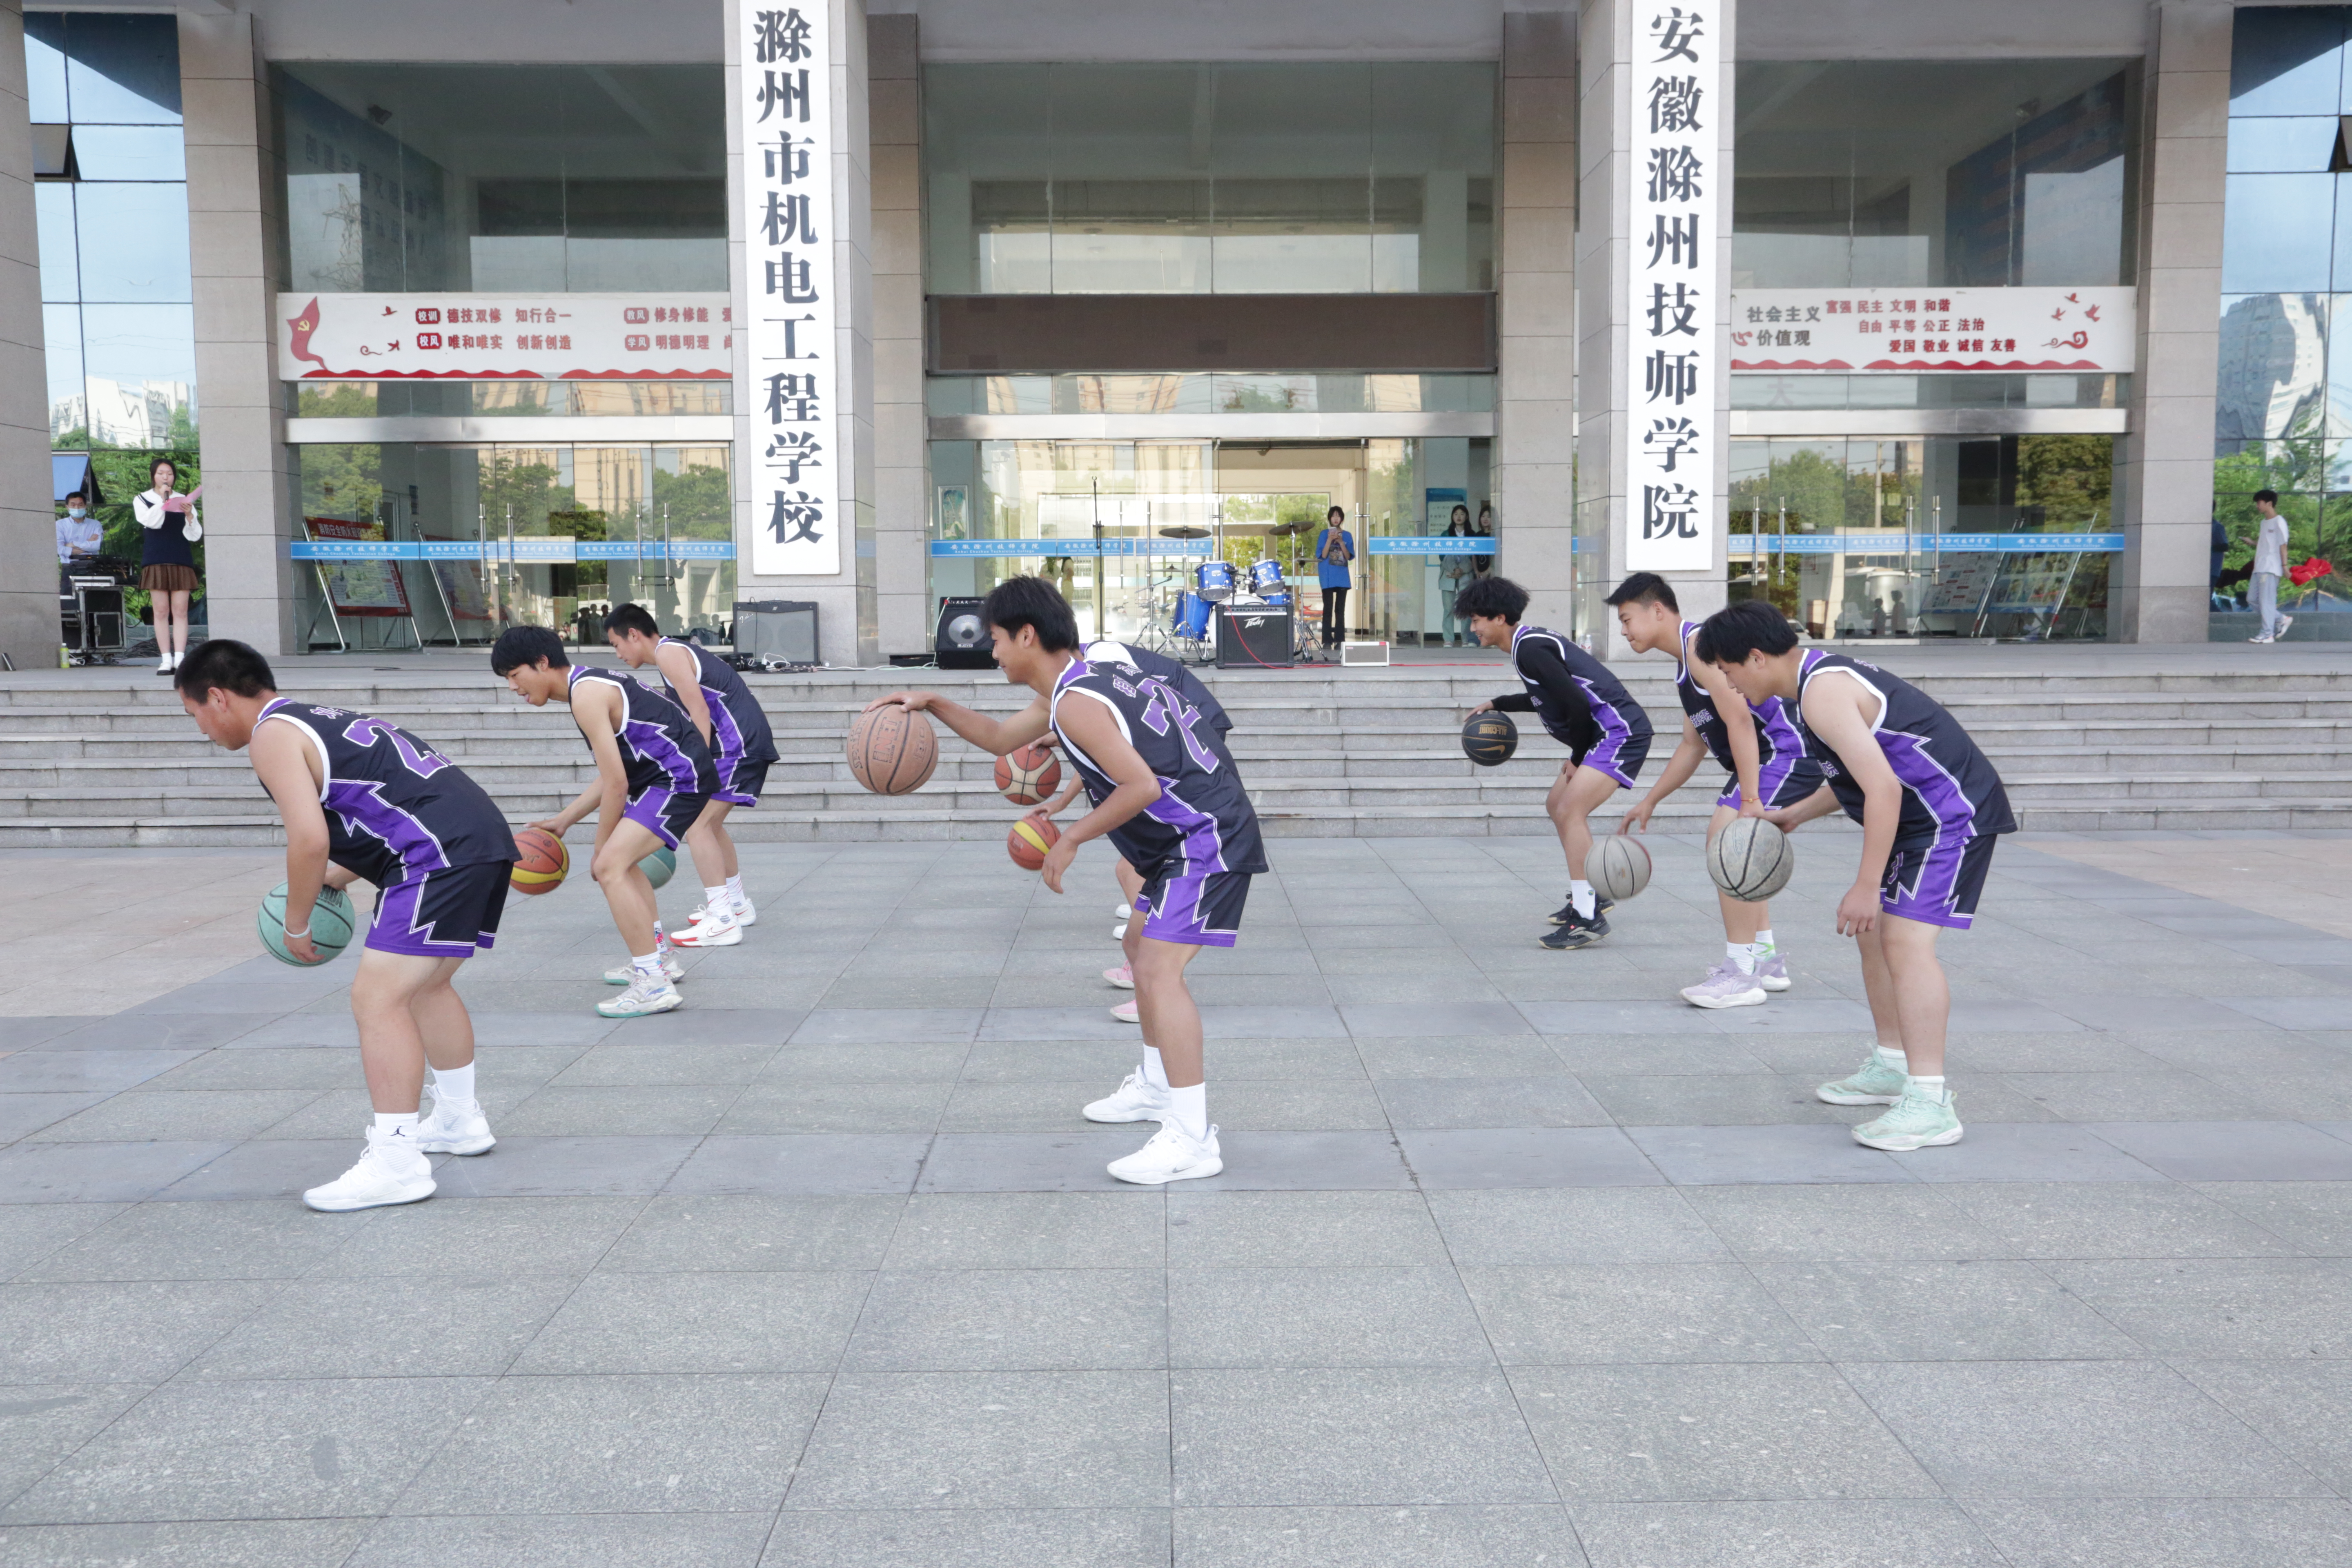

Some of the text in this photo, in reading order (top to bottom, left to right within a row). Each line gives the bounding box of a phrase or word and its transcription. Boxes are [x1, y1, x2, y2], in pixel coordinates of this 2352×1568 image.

[753, 7, 823, 544] 滁州市机电工程学校
[1643, 7, 1704, 540] 安徽滁州技师学院
[1747, 305, 1821, 323] 社会主义
[1826, 298, 1951, 314] 富强 民主 文明 和谐
[418, 307, 571, 323] 校训 德技双修 知行合一
[626, 310, 646, 321] 教风
[655, 307, 709, 323] 修身修能
[1859, 317, 1985, 334] 自由 平等 公正 法治
[419, 334, 571, 350] 校风 唯和唯实 创新创造
[628, 337, 647, 348] 学风
[655, 334, 710, 350] 明德明理
[1889, 338, 2016, 353] 爱国 敬业 诚信 友善
[1479, 726, 1507, 736] ALL-COURT
